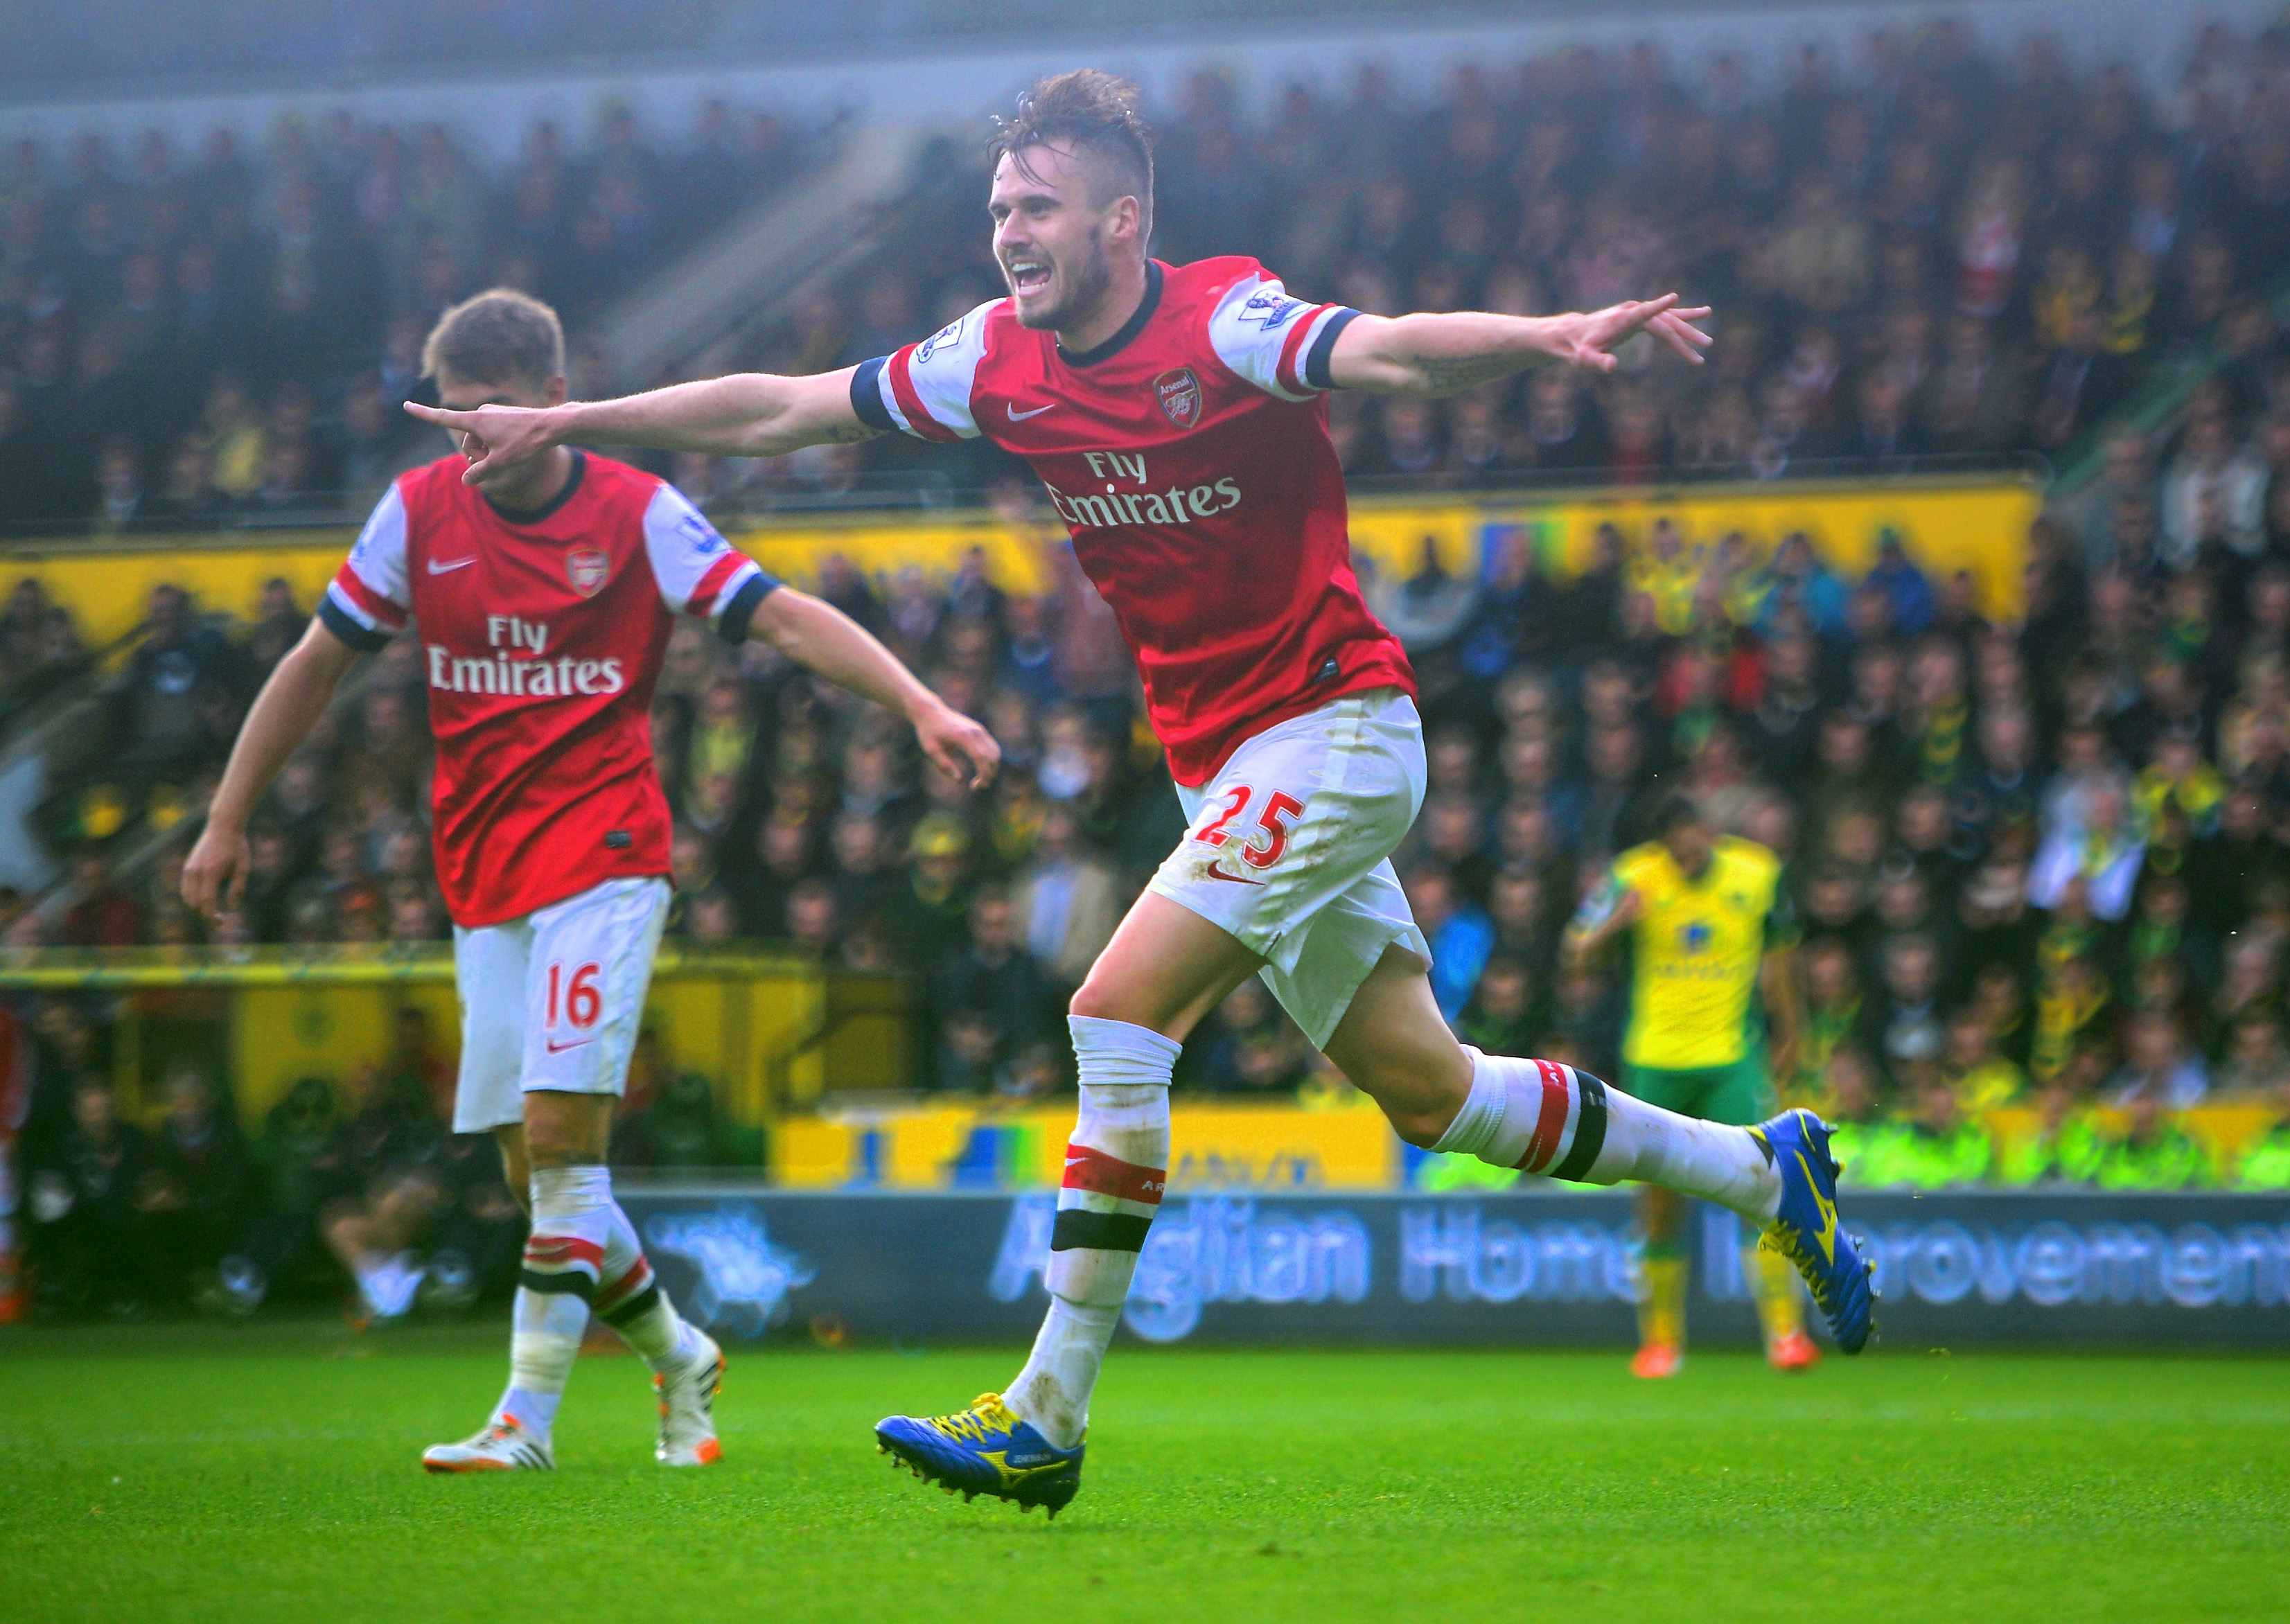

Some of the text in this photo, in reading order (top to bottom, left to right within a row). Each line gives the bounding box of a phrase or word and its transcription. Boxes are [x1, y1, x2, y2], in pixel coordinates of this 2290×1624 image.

[1084, 451, 1148, 484] Fly
[1044, 477, 1242, 527] Emirates
[487, 614, 547, 655] Fly
[428, 644, 624, 696] Emirates
[1191, 784, 1305, 870] 25
[545, 961, 601, 1030] 16
[987, 1193, 1373, 1341] Aglian
